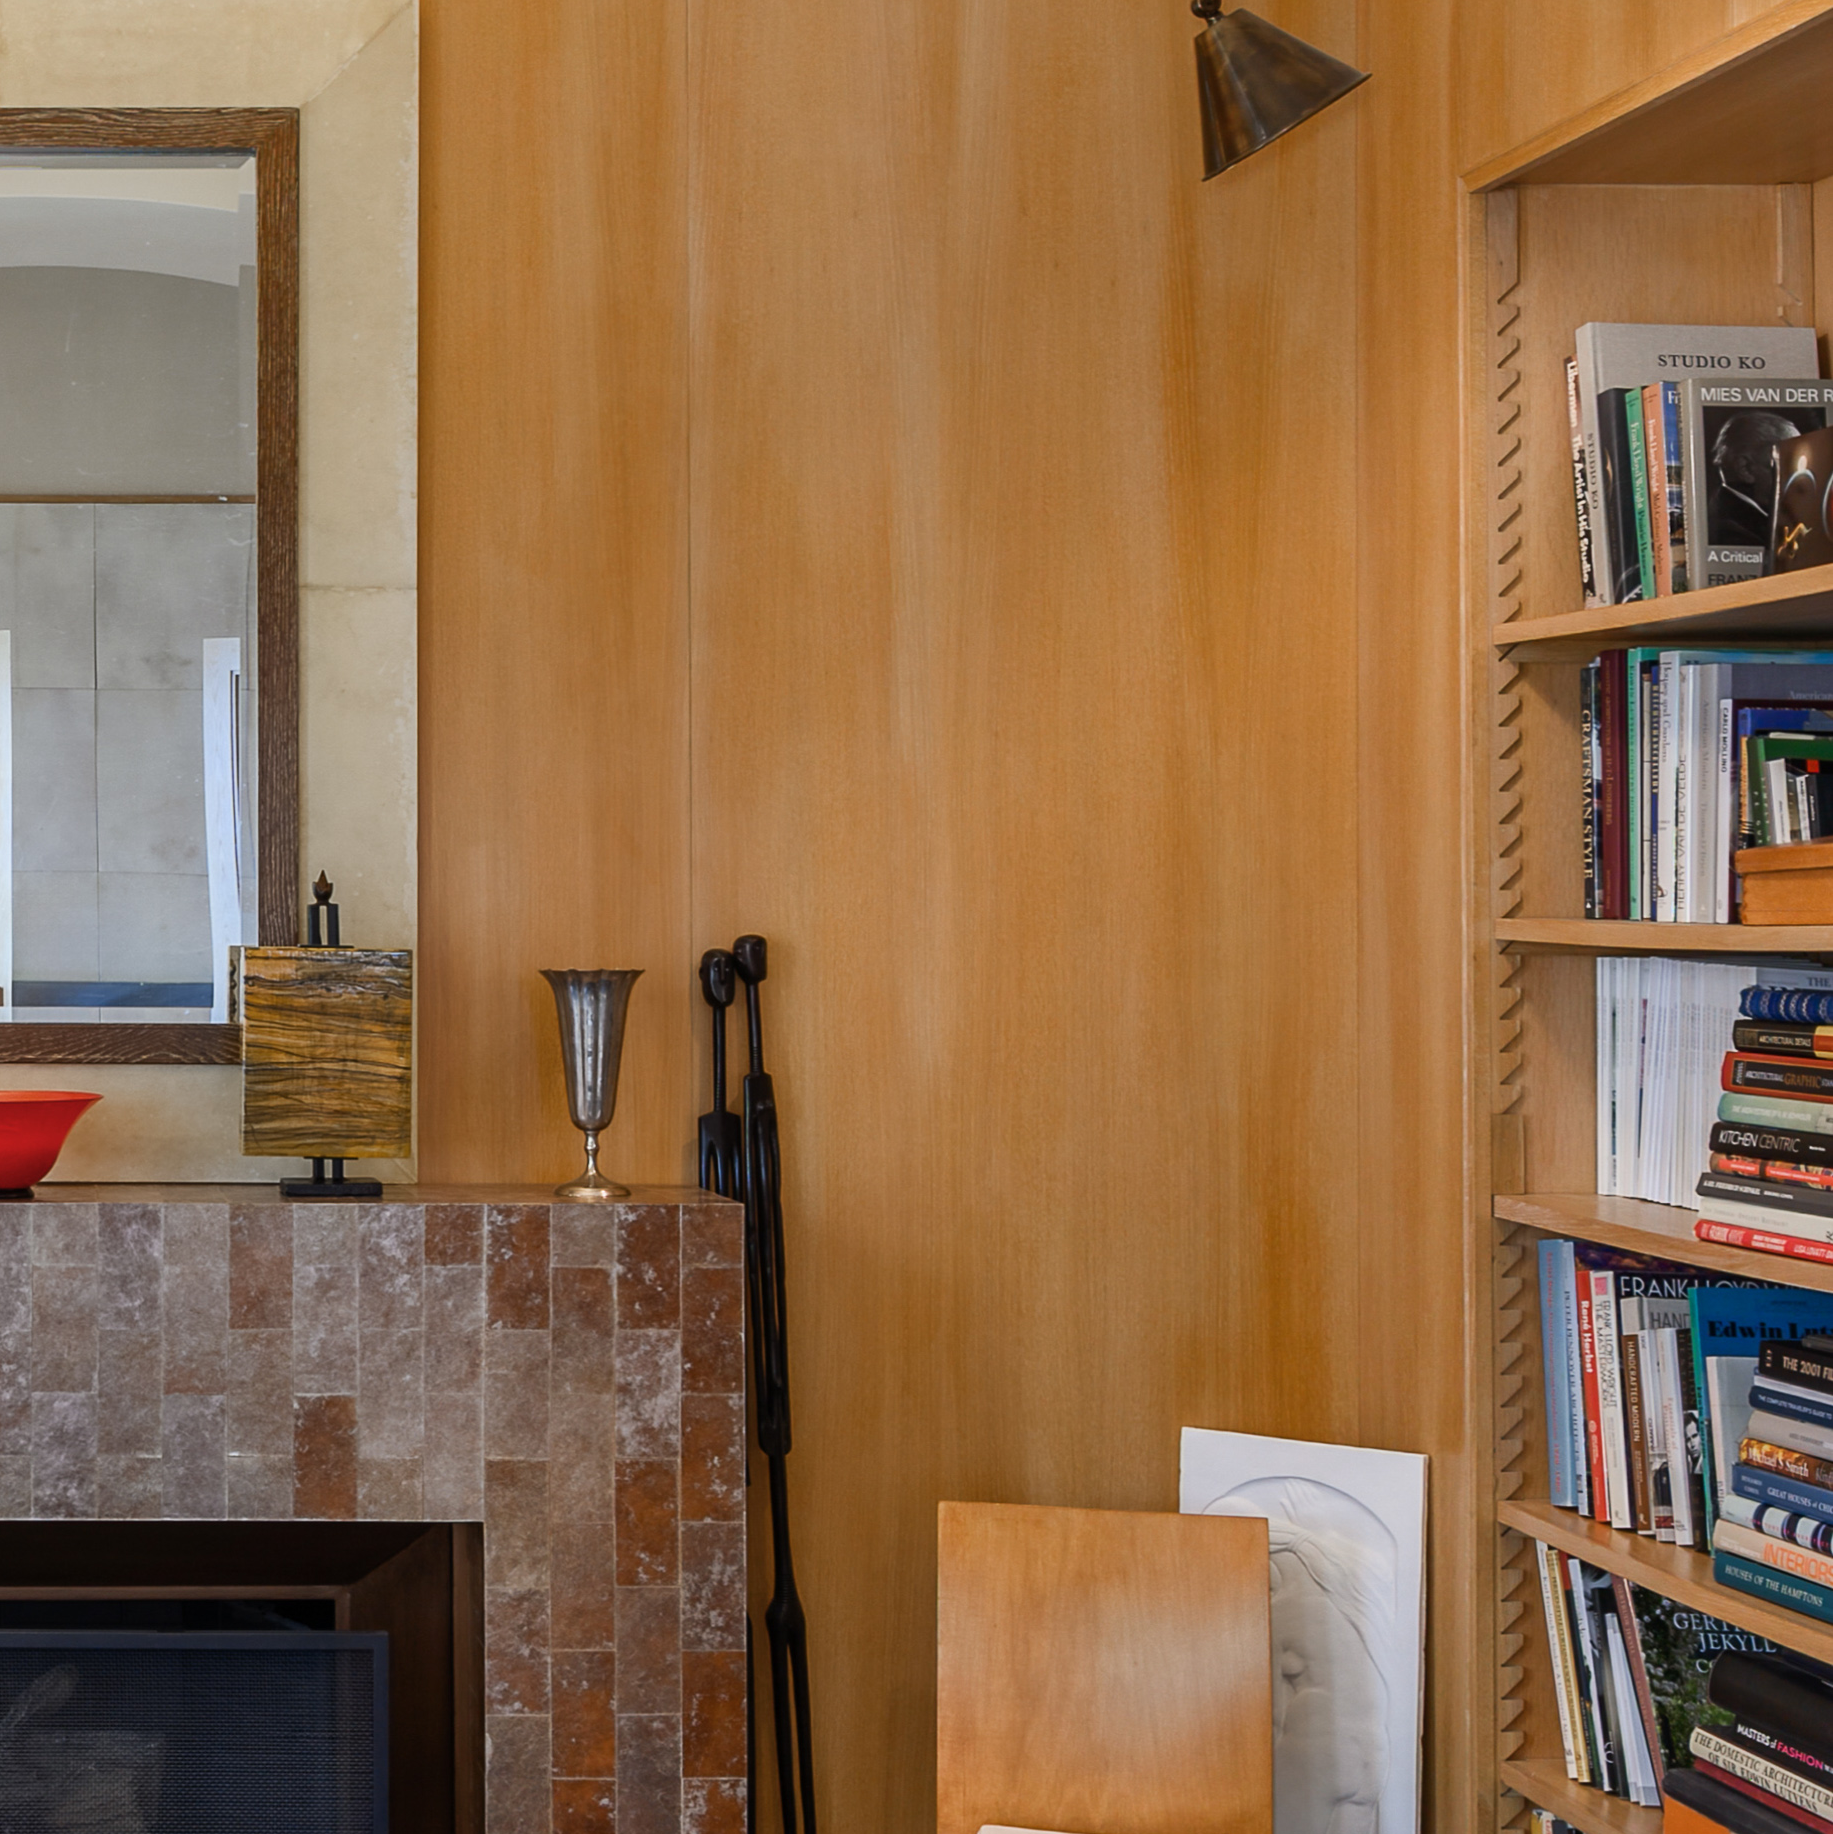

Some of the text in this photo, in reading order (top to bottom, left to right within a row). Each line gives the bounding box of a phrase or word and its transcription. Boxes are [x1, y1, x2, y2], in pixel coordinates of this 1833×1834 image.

[1658, 354, 1766, 369] STUDIO KO
[1701, 387, 1742, 402] MIES
[1745, 387, 1782, 402] VAN
[1785, 388, 1819, 403] DER
[1629, 421, 1641, 449] Frank
[1648, 419, 1657, 442] Frank
[1631, 450, 1643, 477] Lloyd
[1648, 443, 1657, 464] Lloyd
[1564, 361, 1591, 582] Liberman The Artist In His Studio
[1586, 432, 1599, 510] STUDIO KO
[1649, 465, 1659, 491] Wright
[1633, 477, 1645, 508] Wright
[1707, 550, 1763, 564] A Critical
[1701, 700, 1710, 748] American
[1720, 736, 1728, 772] MOLLINO
[1700, 750, 1709, 790] Modern
[1580, 709, 1593, 879] CRAFTSMAN STYLE
[1678, 804, 1684, 823] DE
[1808, 977, 1830, 987] THE
[1784, 1072, 1822, 1089] GRAPHIC
[1718, 1129, 1801, 1153] KITCHEN CENTRIC
[1620, 1276, 1688, 1298] FRANK
[1563, 1290, 1572, 1325] PETER
[1580, 1299, 1594, 1373] René Herbst
[1707, 1320, 1782, 1339] Edwin
[1566, 1327, 1576, 1388] PENNOYER
[1594, 1303, 1610, 1408] THE MASTERWORKS
[1601, 1299, 1617, 1408] FRANK LLOYD WRIGHT
[1783, 1356, 1798, 1370] THE
[1800, 1361, 1821, 1377] 2001
[1625, 1341, 1641, 1441] HANDCRAFTED MODERN
[1748, 1448, 1777, 1466] Michael
[1785, 1457, 1809, 1477] Smith
[1767, 1487, 1786, 1499] GREAT
[1787, 1492, 1811, 1507] HOUSES
[1763, 1543, 1833, 1583] INTERIORS
[1541, 1576, 1549, 1594] Karl
[1725, 1564, 1824, 1607] HOUSES OF THE HAMPTONS
[1544, 1595, 1554, 1631] Friedrich
[1624, 1627, 1636, 1654] JEKYLL
[1698, 1633, 1777, 1653] JEKYLL
[1694, 1731, 1715, 1750] THE
[1714, 1739, 1759, 1772] DOMESTIC
[1737, 1723, 1771, 1747] MASTERS
[1777, 1740, 1823, 1770] FASHION
[1708, 1752, 1819, 1815] OF SIR EDWIN LUTYENS
